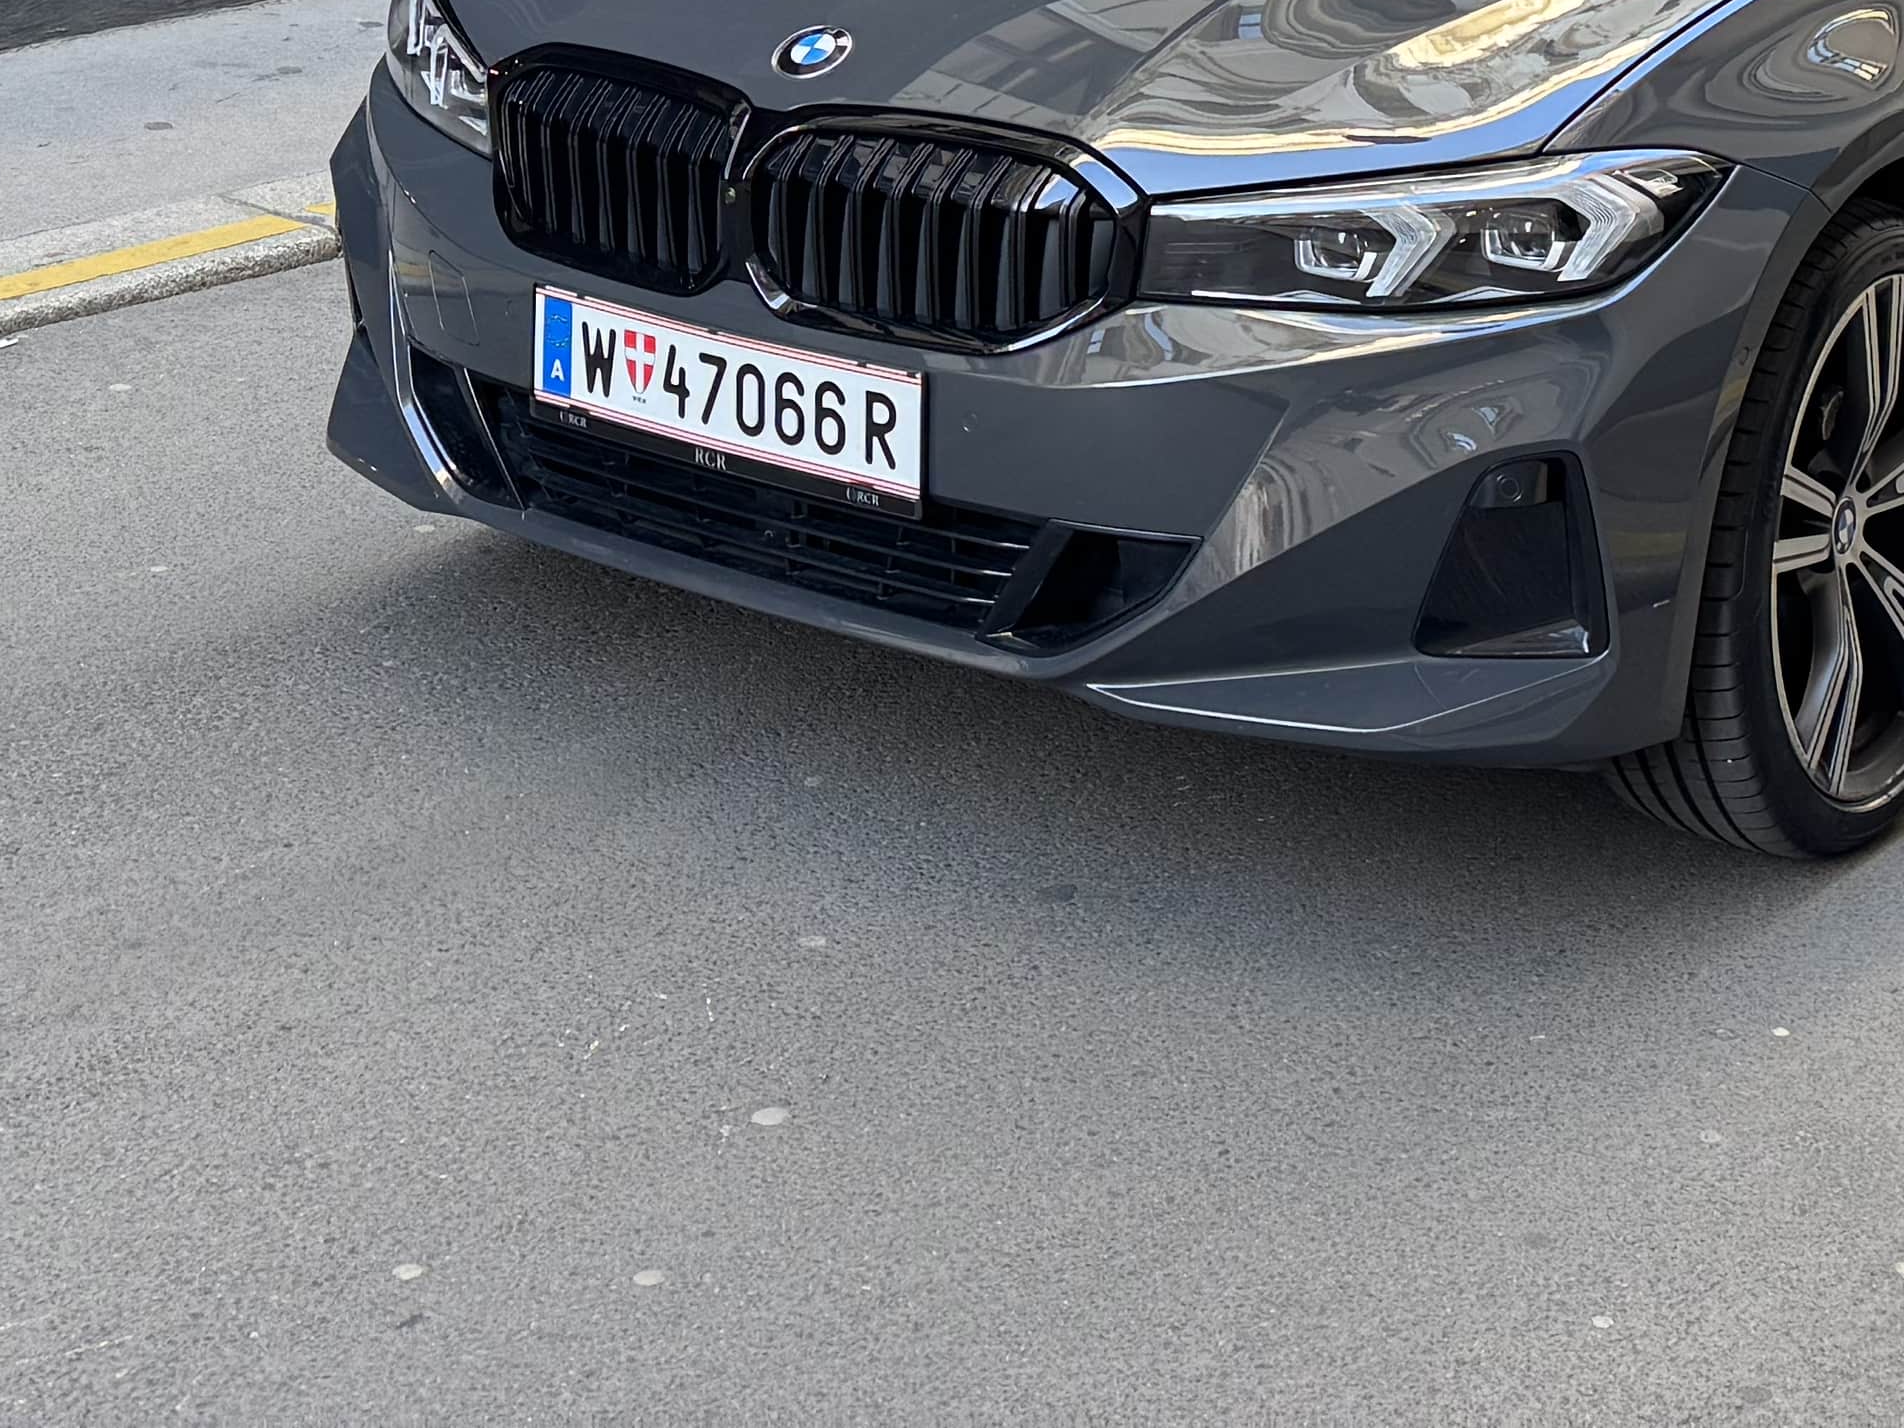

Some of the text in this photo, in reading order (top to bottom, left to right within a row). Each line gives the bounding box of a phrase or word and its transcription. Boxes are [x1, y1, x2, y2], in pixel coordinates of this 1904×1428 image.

[550, 361, 565, 382] A
[581, 320, 617, 399] W
[695, 447, 728, 472] RCR
